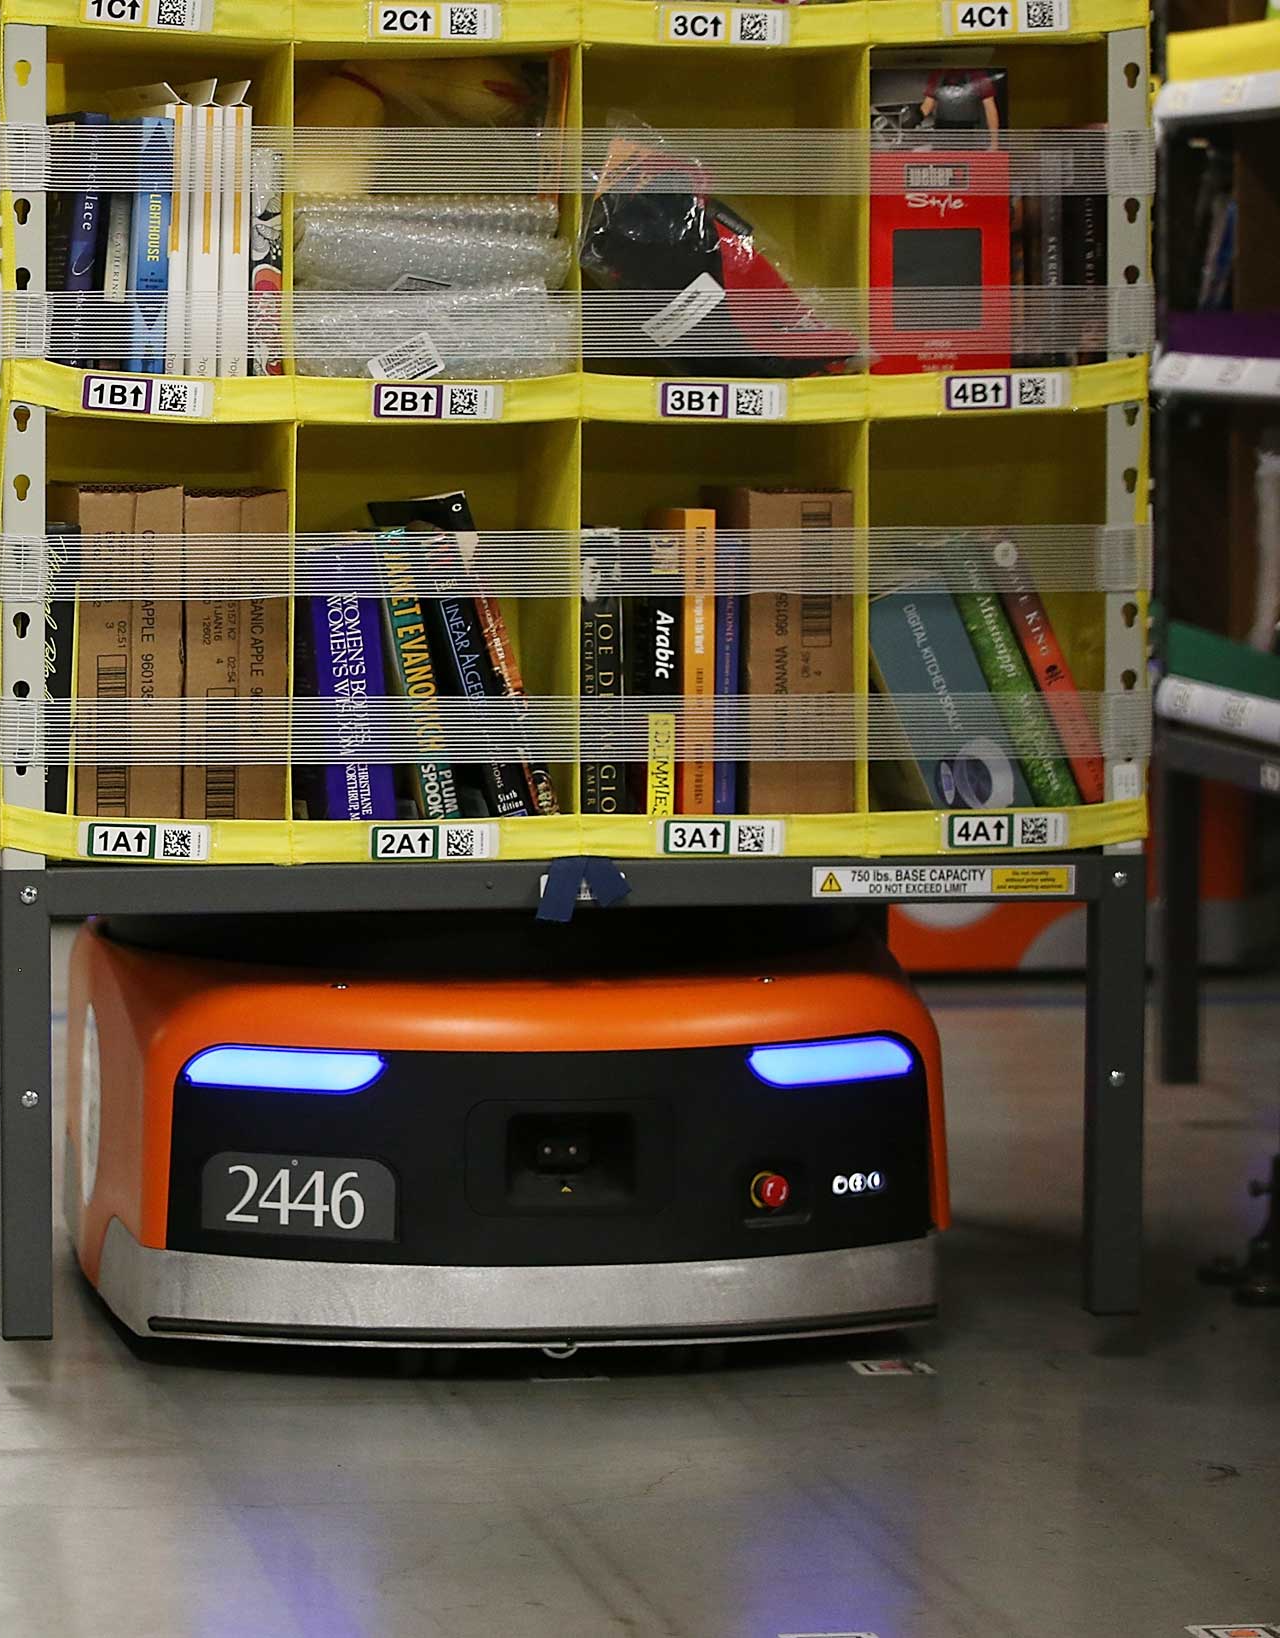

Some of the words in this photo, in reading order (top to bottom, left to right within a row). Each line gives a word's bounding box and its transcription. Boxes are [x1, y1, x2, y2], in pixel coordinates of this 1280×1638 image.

[91, 0, 127, 19] 1C
[383, 9, 418, 31] 2C
[960, 6, 996, 28] 4C
[673, 15, 709, 37] 3C
[904, 192, 965, 218] Style
[146, 193, 162, 262] LIGHTHOUSE
[93, 383, 128, 405] 1B
[383, 390, 418, 412] 2B
[670, 390, 706, 411] 3B
[953, 383, 989, 404] 4B
[326, 592, 349, 677] WOMEN'S
[341, 591, 366, 676] WOMEN'S
[594, 612, 615, 656] JOE
[976, 595, 1018, 679] Mississippi
[1024, 609, 1050, 657] KING
[655, 609, 676, 680] Arabic
[902, 603, 928, 647] DIGITAL
[921, 645, 951, 698] KITCHEN
[249, 636, 264, 677] APPLE
[583, 621, 596, 694] RICHARD
[438, 768, 459, 814] PLUM
[497, 789, 518, 803] Sixth
[496, 800, 524, 814] Edition
[98, 830, 132, 852] 1A
[673, 827, 708, 849] 3A
[957, 820, 991, 842] 4A
[381, 833, 416, 854] 2A
[851, 870, 870, 882] 750
[873, 869, 892, 882] lbs.
[895, 869, 926, 882] BASE
[929, 868, 986, 881] CAPACITY
[869, 883, 882, 893] DO
[885, 883, 902, 893] NOT
[905, 883, 942, 893] EXCEED
[944, 882, 967, 893] LIMIT
[224, 1165, 366, 1230] 2446
